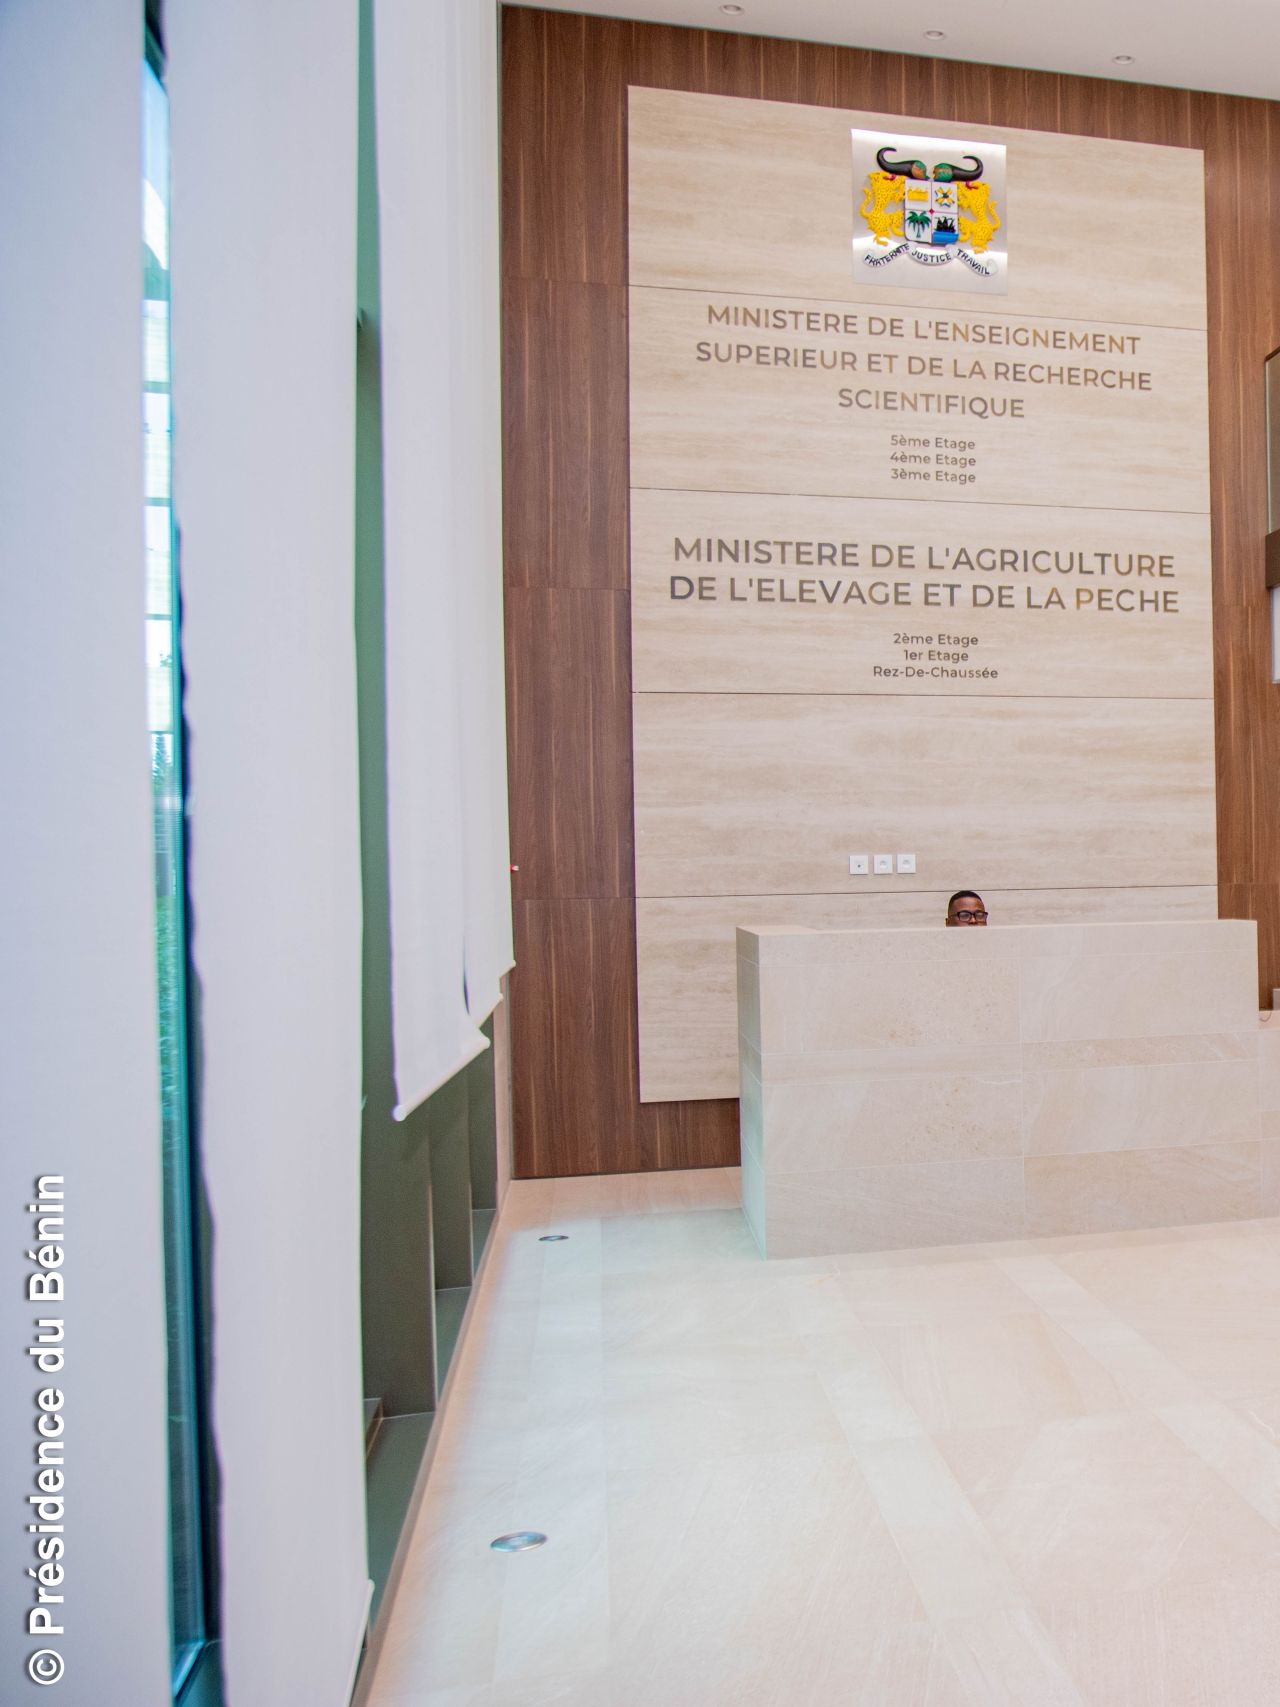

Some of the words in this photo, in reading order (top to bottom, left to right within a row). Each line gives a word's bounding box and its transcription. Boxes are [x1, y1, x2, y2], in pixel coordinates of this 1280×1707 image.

[911, 250, 952, 263] JUSTICE
[956, 248, 990, 275] TRAVAIL
[707, 304, 859, 335] MINISTERE
[868, 316, 905, 338] DE
[914, 319, 1141, 355] L'ENSEIGNEMENT
[695, 341, 858, 372] SUPERIEUR
[867, 353, 899, 374] ET
[907, 355, 944, 377] DE
[953, 358, 987, 380] LA
[994, 361, 1152, 392] RECHERCHE
[838, 388, 1025, 420] SCIENTIFIQUE
[890, 434, 931, 448] 5ème
[934, 436, 976, 453] Etage
[889, 451, 931, 464] 4ème
[935, 453, 977, 469] Etage
[890, 467, 931, 481] 3ème
[935, 470, 976, 486] Etage
[674, 537, 860, 568] MINISTERE
[871, 544, 916, 569] DE
[928, 546, 1176, 578] L'AGRICULTURE
[669, 575, 718, 602] DE
[729, 577, 912, 606] L'ELEVAGE
[923, 582, 962, 607] ET
[972, 584, 1015, 609] DE
[1026, 586, 1067, 610] LA
[1075, 587, 1179, 614] PECHE
[893, 632, 934, 645] 2ème
[937, 633, 979, 649] Etage
[903, 649, 924, 661] 1er
[927, 649, 969, 665] Etage
[873, 665, 999, 679] Rez-De-Chaussée
